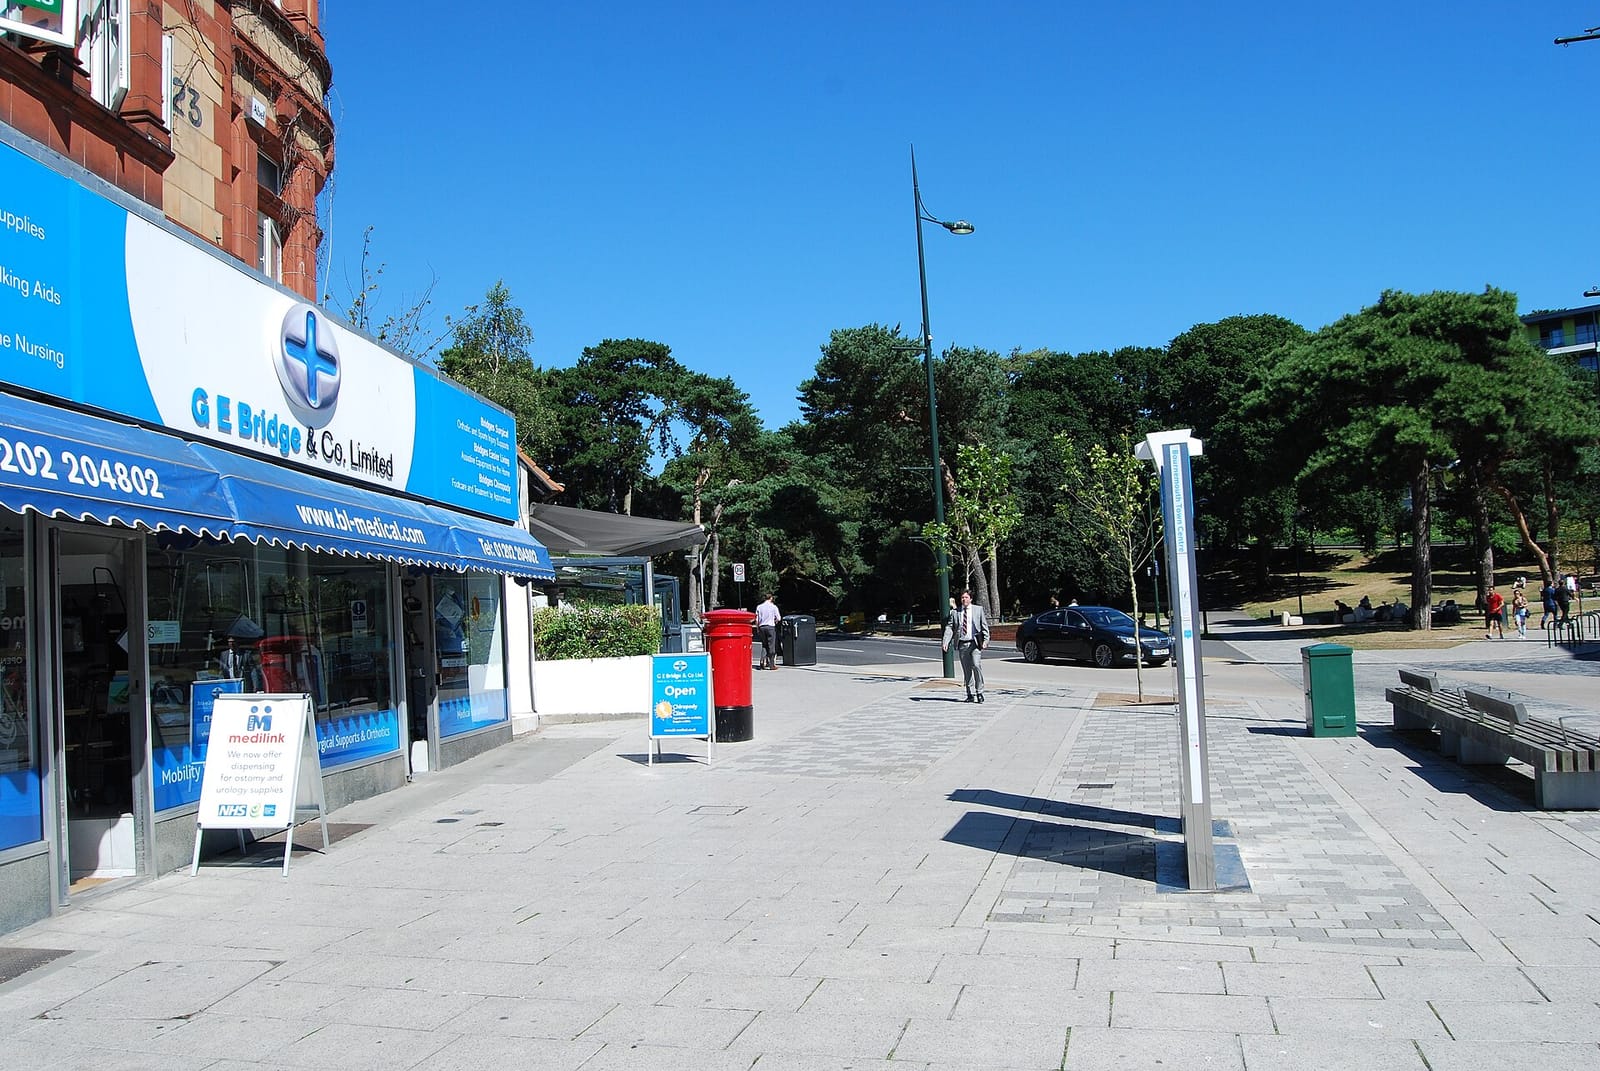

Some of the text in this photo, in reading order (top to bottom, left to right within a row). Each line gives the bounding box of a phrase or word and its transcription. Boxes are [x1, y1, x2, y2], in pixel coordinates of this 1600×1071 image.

[33, 280, 61, 305] Aids
[16, 333, 64, 370] Nursing
[191, 387, 394, 479] G E Bridge & Co. Limited
[0, 438, 165, 498] 202 204802
[1172, 449, 1180, 502] Bournemouth
[296, 504, 427, 544] www.bl-medical.com
[664, 685, 697, 698] Open
[229, 733, 285, 743] medilink
[335, 732, 360, 748] Supports
[360, 730, 366, 741] &
[162, 764, 200, 786] Mobility
[231, 762, 275, 772] dispensing
[220, 773, 232, 782] for
[234, 775, 265, 784] ostomy
[216, 786, 283, 796] urology supplies
[219, 805, 247, 816] NHS
